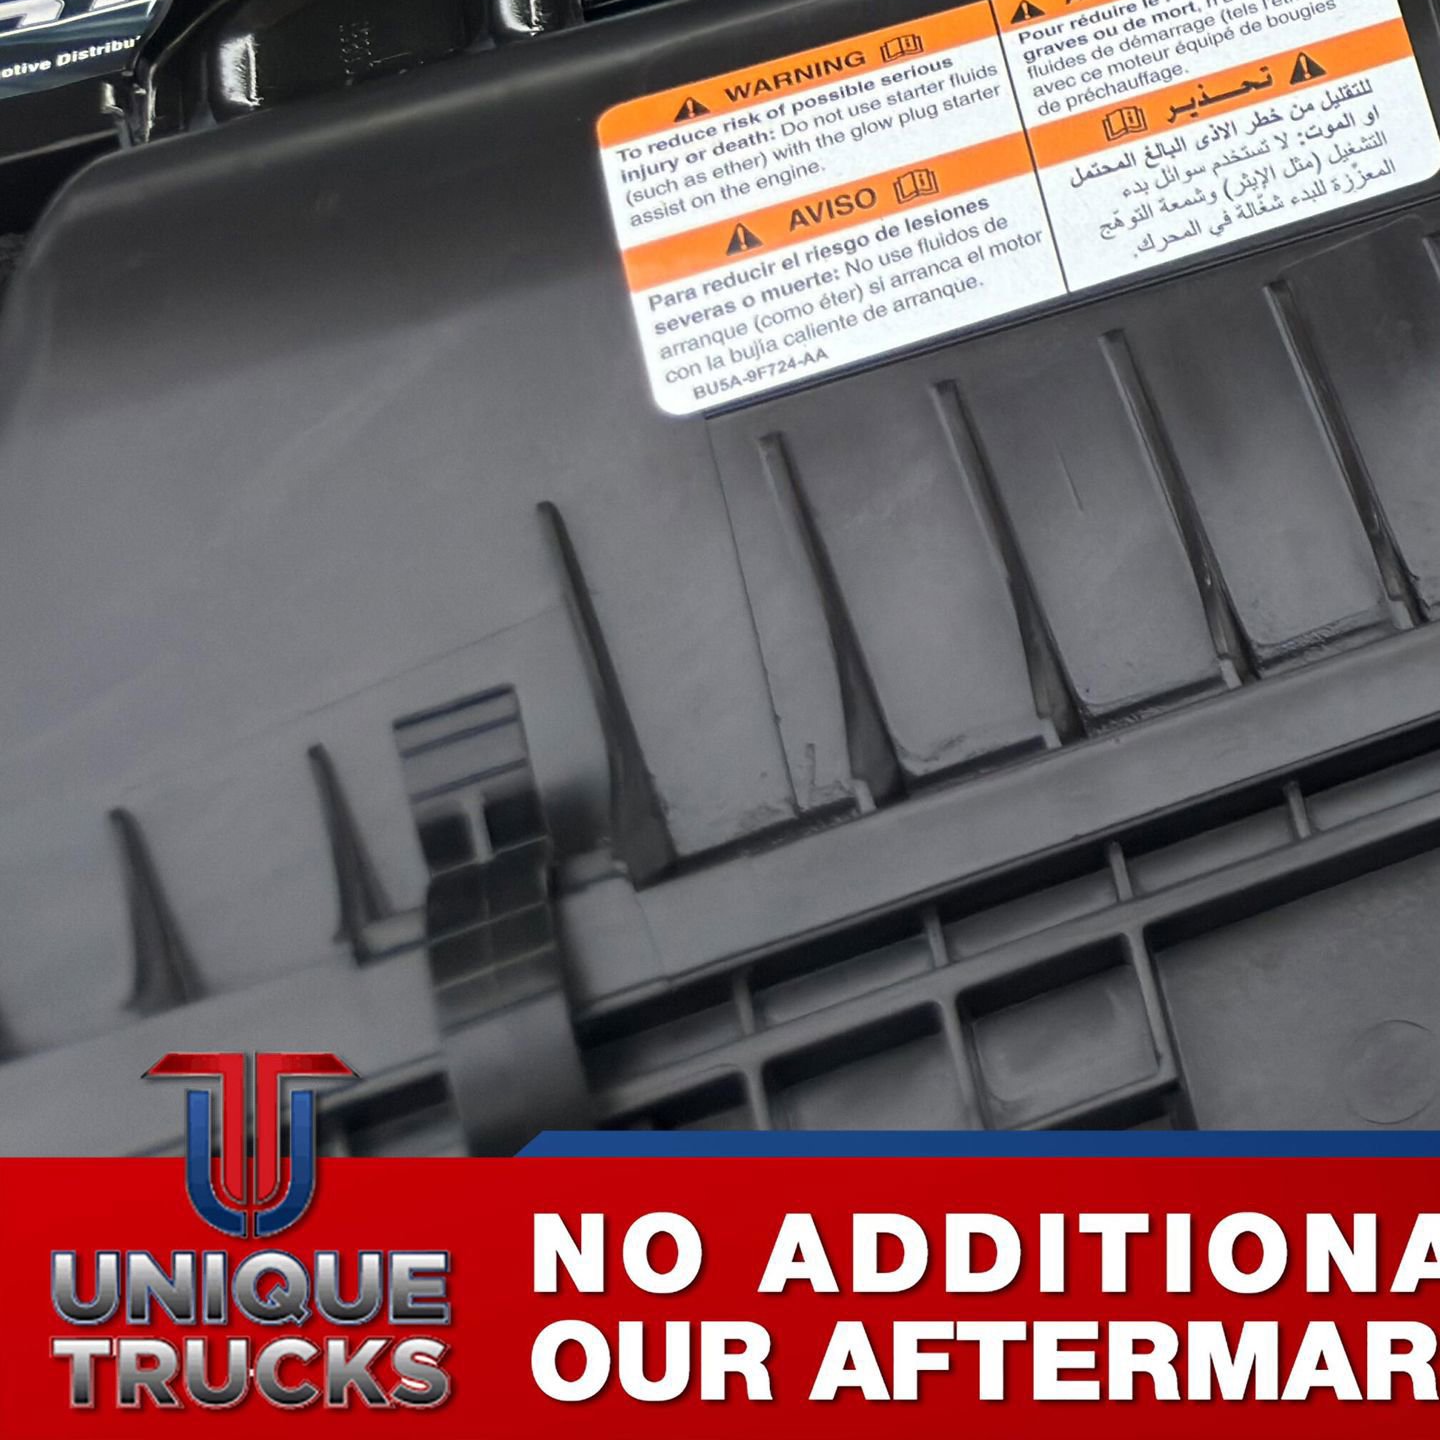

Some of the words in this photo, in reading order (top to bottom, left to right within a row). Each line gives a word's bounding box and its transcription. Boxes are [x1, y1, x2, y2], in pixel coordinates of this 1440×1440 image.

[1018, 23, 1065, 45] Pour
[1069, 2, 1138, 31] réduire
[1022, 34, 1089, 64] graves
[1092, 25, 1119, 41] ou
[1122, 17, 1147, 32] de
[1026, 53, 1088, 80] fluides
[1090, 45, 1115, 61] de
[1118, 15, 1216, 53] démarrage
[1220, 2, 1259, 25] (tels
[1032, 75, 1077, 98] avec
[1080, 68, 1103, 83] ce
[1106, 47, 1170, 76] moteur
[1174, 26, 1235, 55] équipé
[1239, 20, 1263, 36] de
[1265, 0, 1337, 29] bougies
[615, 147, 643, 163] To
[647, 126, 718, 155] reduce
[722, 112, 762, 133] risk
[765, 103, 786, 120] of
[791, 80, 876, 116] possible
[880, 57, 954, 87] serious
[620, 157, 679, 184] injury
[685, 149, 707, 165] or
[712, 129, 776, 157] death:
[780, 120, 809, 137] Do
[813, 107, 844, 128] not
[847, 98, 882, 118] use
[886, 79, 945, 106] starter
[949, 64, 998, 88] fluids
[723, 50, 866, 103] WARNING
[1037, 100, 1062, 117] de
[625, 178, 679, 208] (such
[683, 171, 708, 188] as
[712, 151, 768, 179] ether)
[772, 140, 812, 162] with
[815, 130, 846, 149] the
[850, 116, 893, 143] glow
[898, 103, 939, 129] plug
[942, 84, 1001, 112] starter
[629, 198, 687, 228] assist
[690, 192, 716, 209] on
[719, 182, 751, 201] the
[755, 161, 826, 190] engine.
[647, 287, 698, 312] Para
[702, 261, 776, 296] reducir
[781, 251, 801, 271] el
[805, 234, 870, 264] riesgo
[874, 225, 900, 243] de
[904, 197, 990, 234] lesiones
[789, 187, 877, 232] AVISO
[654, 300, 737, 336] severas
[741, 294, 756, 309] o
[760, 268, 841, 303] muerte:
[844, 258, 874, 277] No
[877, 246, 913, 267] use
[917, 225, 980, 255] fluidos
[983, 216, 1009, 234] de
[660, 322, 748, 361] arranque
[753, 302, 815, 334] (como
[819, 282, 864, 310] éter)
[868, 275, 886, 295] si
[890, 256, 964, 289] arranca
[967, 245, 985, 264] el
[988, 230, 1042, 258] motor
[664, 362, 703, 384] con
[705, 355, 726, 371] la
[782, 313, 858, 347] caliente
[862, 304, 888, 322] de
[892, 276, 985, 313] arranque.
